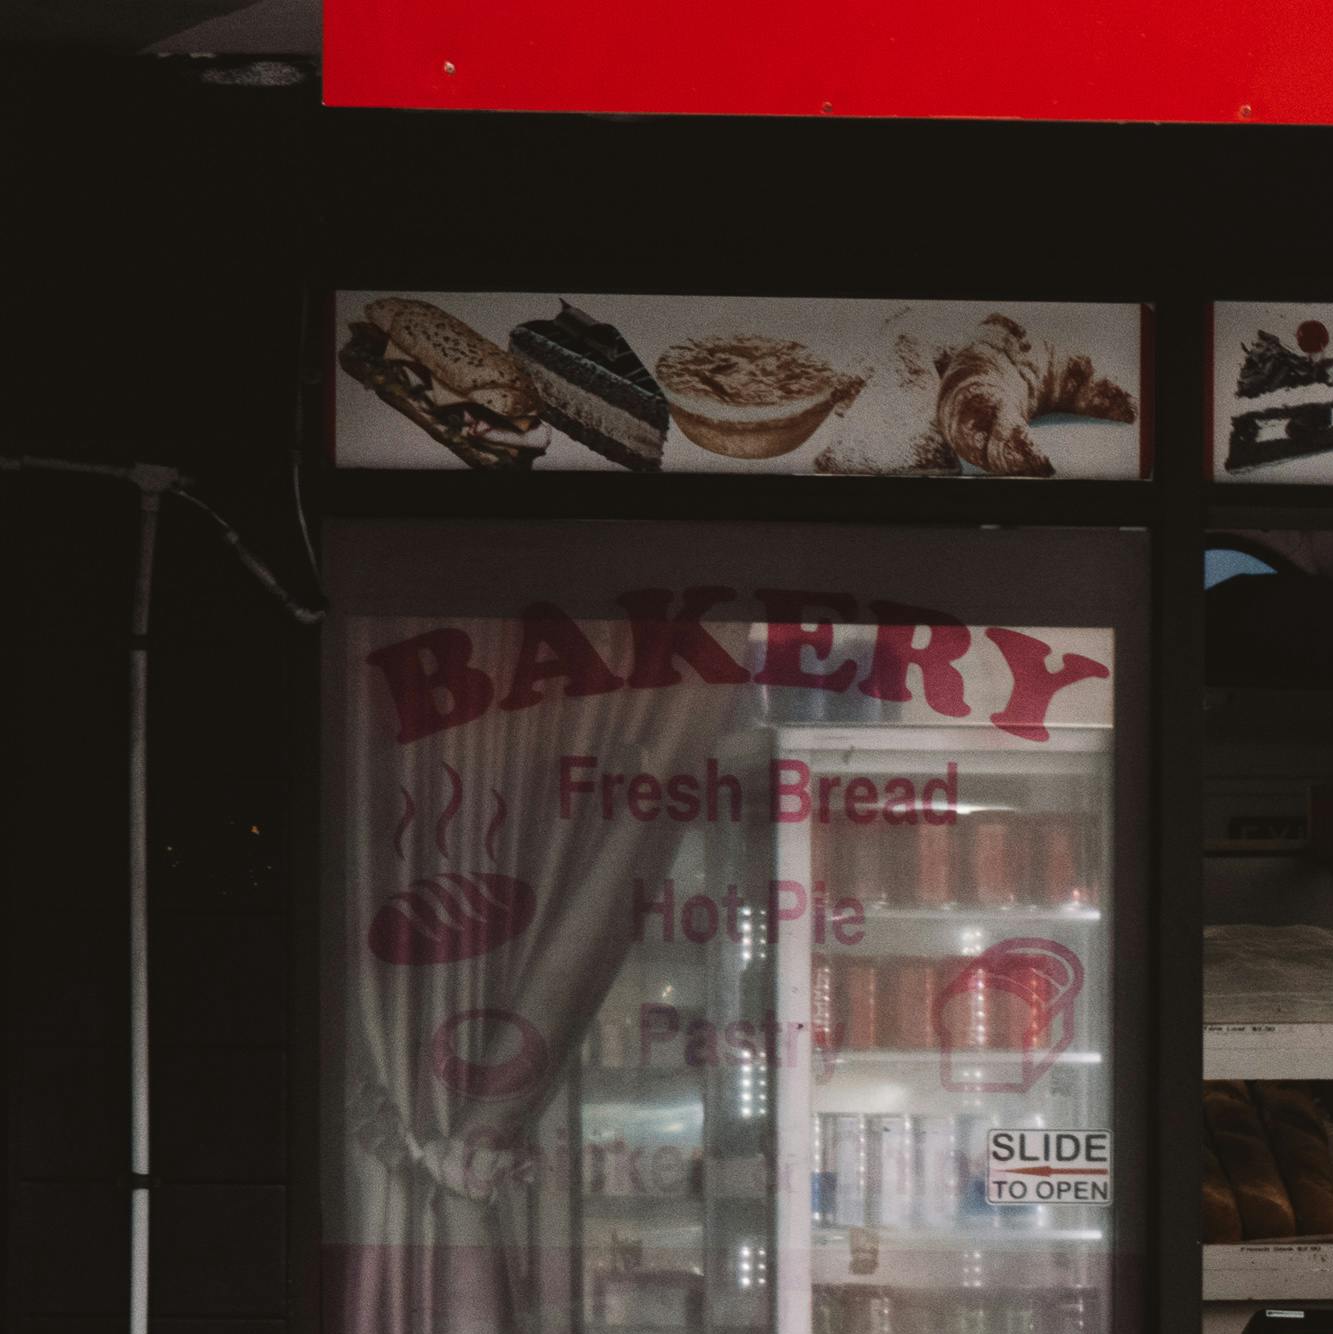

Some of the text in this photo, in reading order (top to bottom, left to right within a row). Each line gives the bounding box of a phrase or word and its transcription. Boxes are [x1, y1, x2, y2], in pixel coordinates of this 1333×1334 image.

[366, 586, 1111, 745] BAKERY
[560, 756, 959, 826] Fresh Bread
[633, 880, 866, 945] Hot Pie
[640, 1003, 846, 1082] Pastry
[992, 1133, 1107, 1162] SLIDE
[992, 1181, 1108, 1200] TO OPEN
